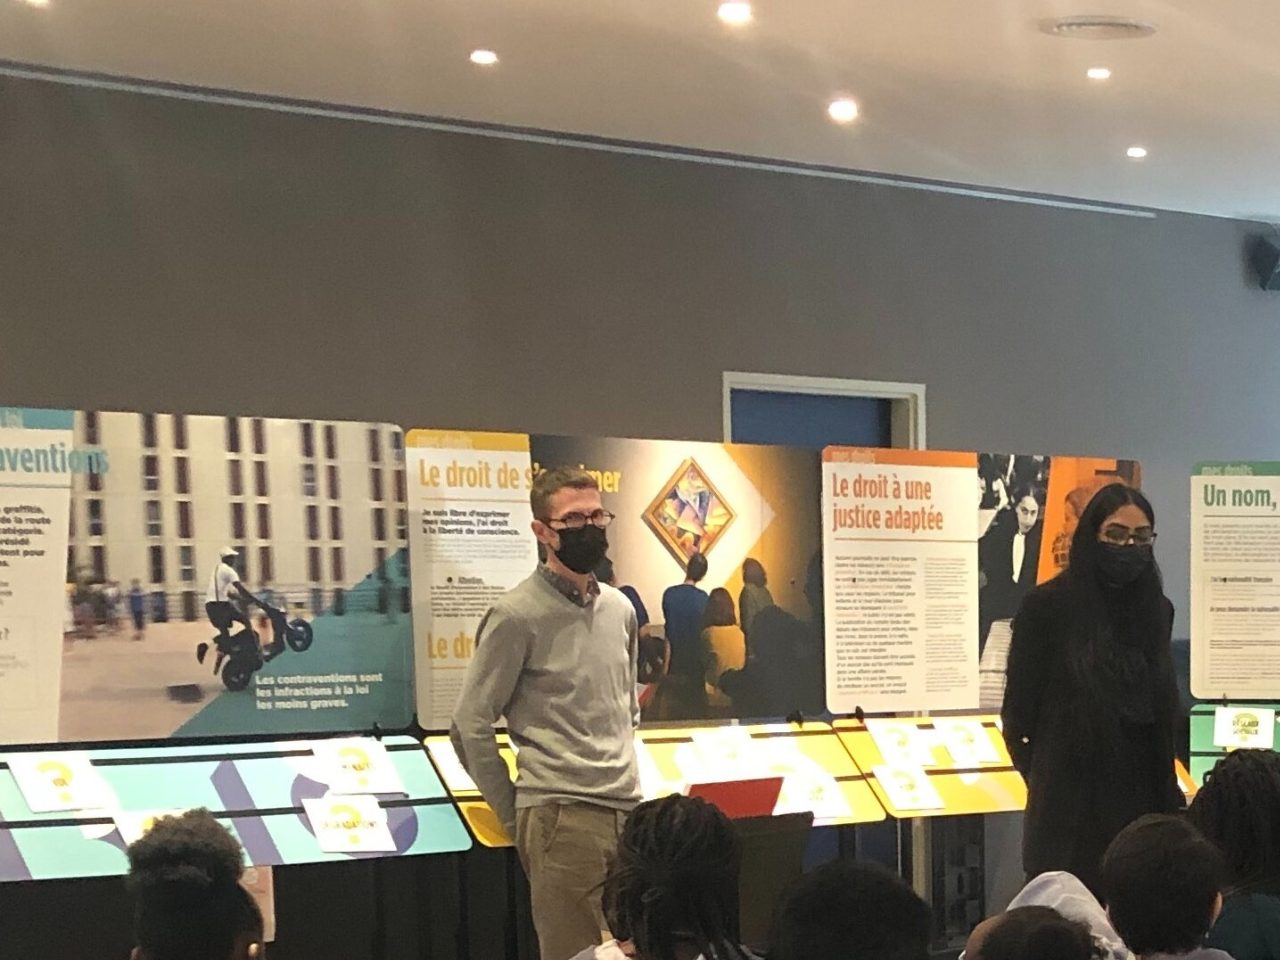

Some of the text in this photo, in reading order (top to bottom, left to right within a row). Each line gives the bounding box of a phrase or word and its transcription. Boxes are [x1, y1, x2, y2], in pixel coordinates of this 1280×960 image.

[419, 458, 440, 487] Le
[446, 459, 492, 489] droit
[497, 461, 520, 489] de
[832, 472, 932, 500] Le droit à une
[1203, 484, 1226, 507] Un
[1231, 488, 1277, 511] nom,
[449, 509, 467, 517] libre
[469, 510, 510, 518] d'exprimer
[832, 504, 943, 533] justice adaptée
[427, 631, 448, 659] Le
[255, 672, 383, 685] Les contraventions sont
[256, 687, 272, 698] les
[274, 686, 333, 697] infractions
[343, 685, 353, 695] la
[355, 684, 369, 694] loi
[256, 699, 349, 710] les moins graves.
